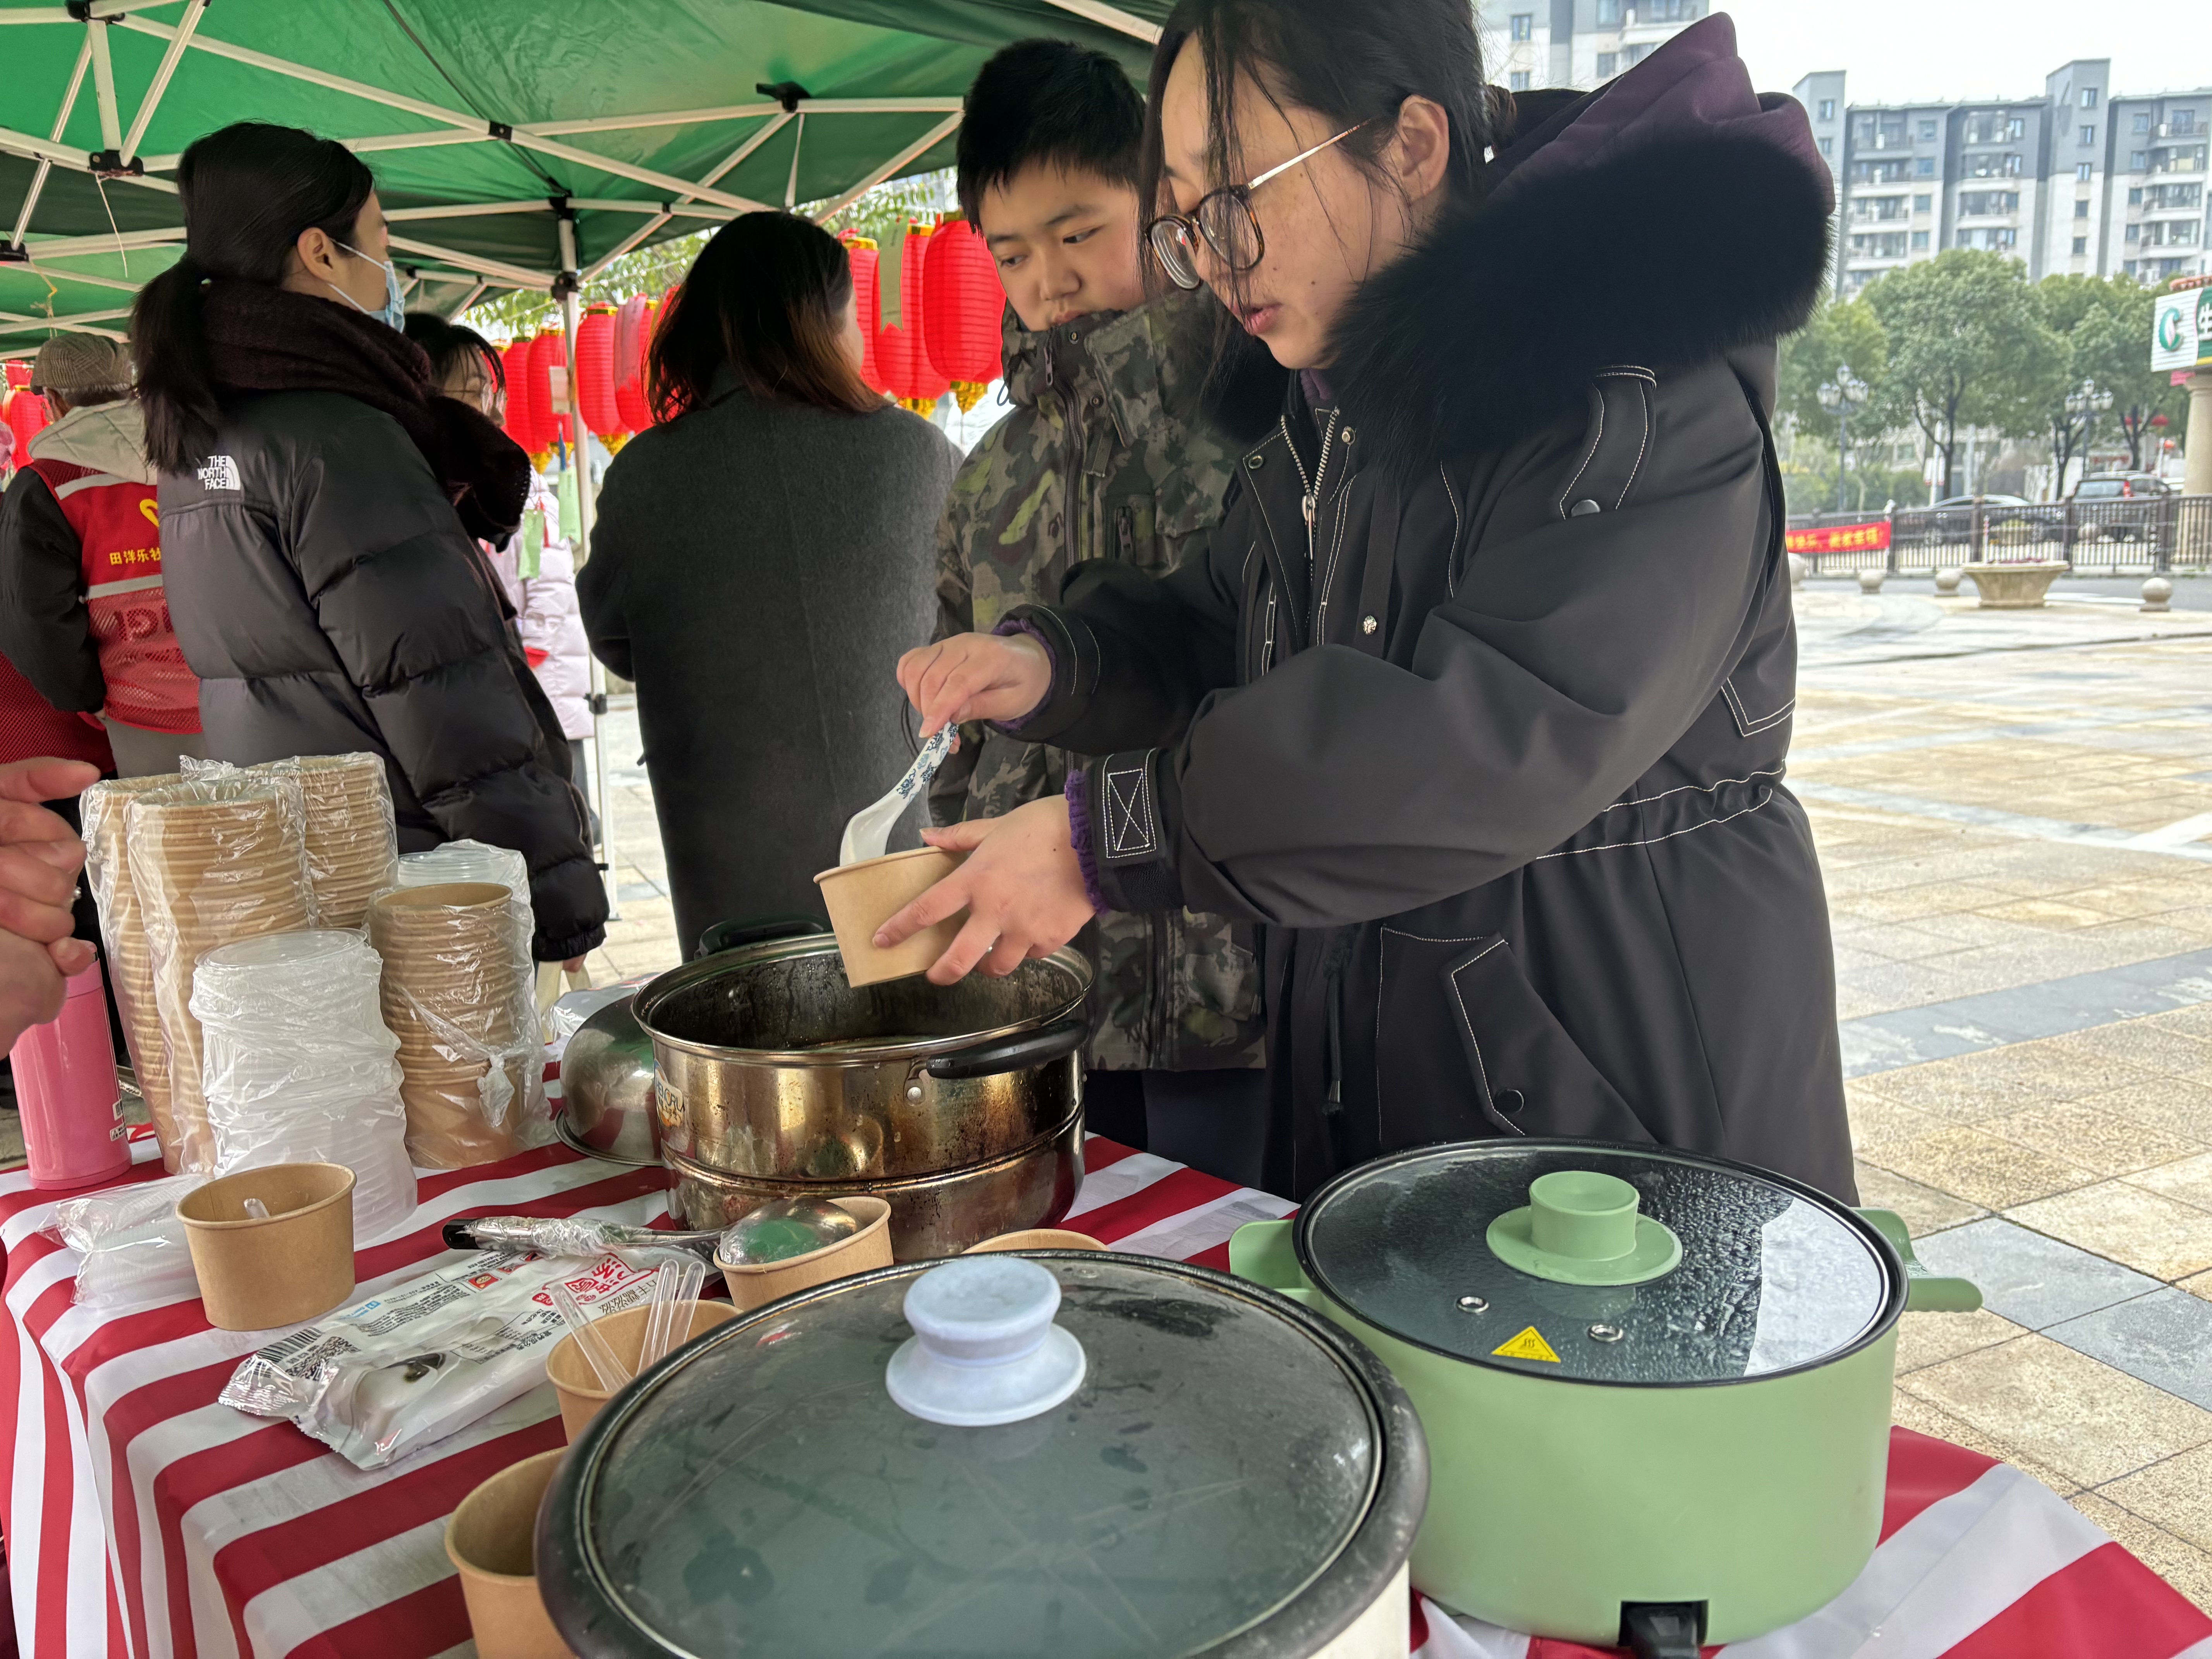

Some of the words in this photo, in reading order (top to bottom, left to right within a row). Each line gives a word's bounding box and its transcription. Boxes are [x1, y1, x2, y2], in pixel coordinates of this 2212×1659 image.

[207, 455, 226, 467] THE
[197, 467, 226, 480] NORTH
[204, 478, 226, 490] FACE
[565, 1258, 622, 1294] 汤圆
